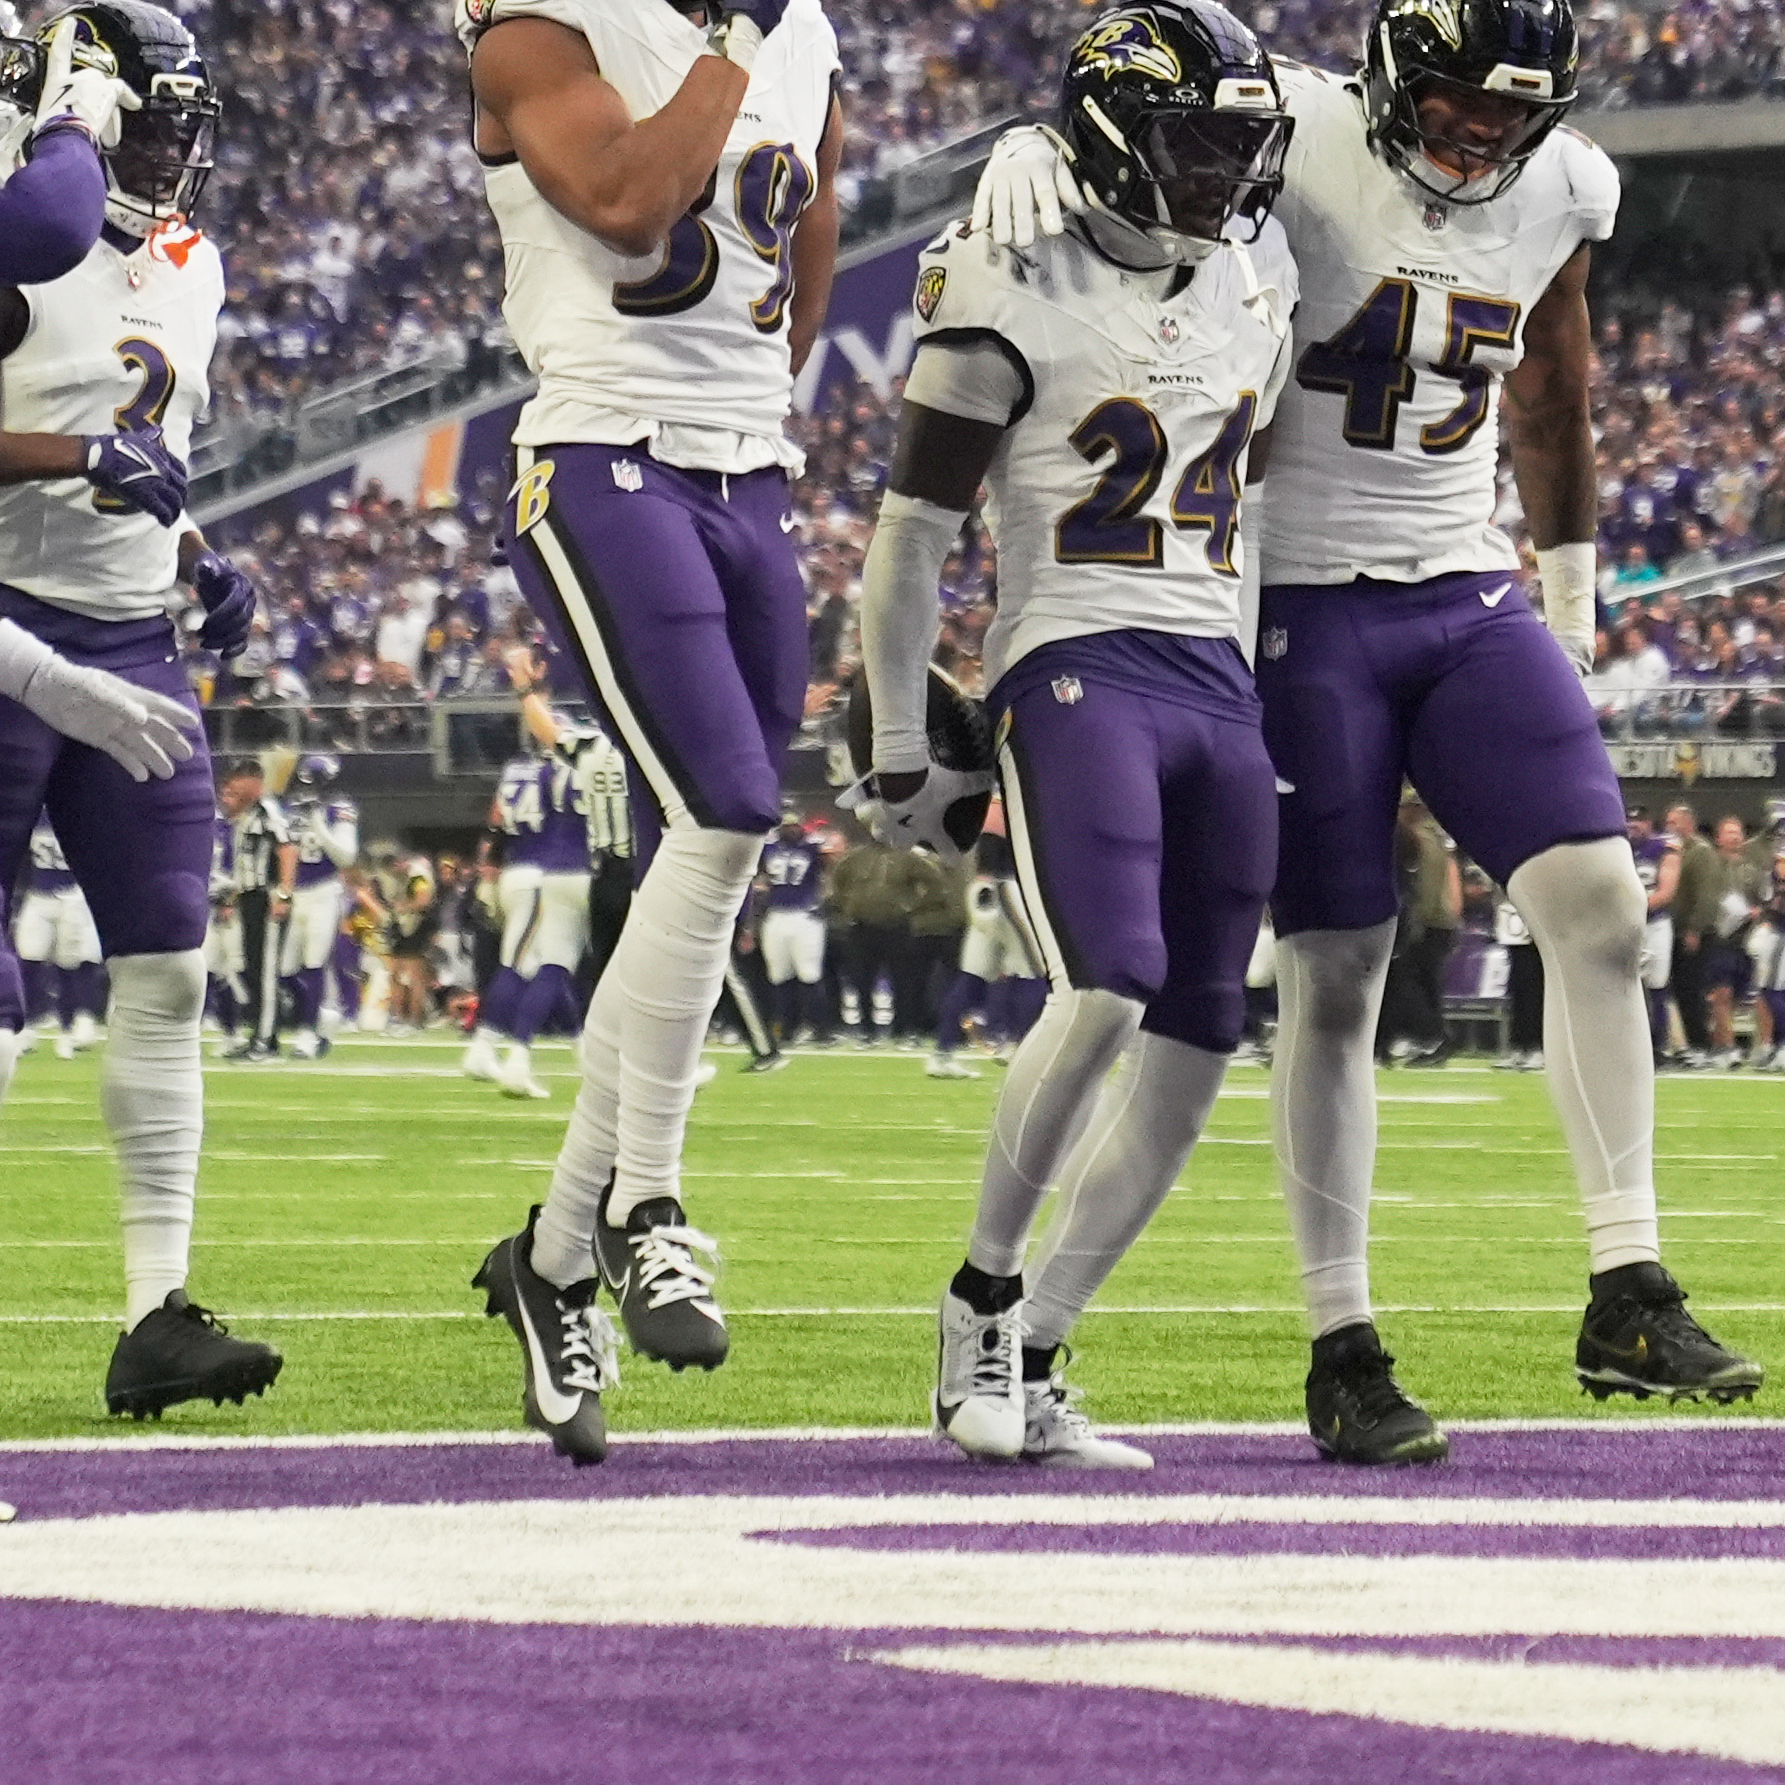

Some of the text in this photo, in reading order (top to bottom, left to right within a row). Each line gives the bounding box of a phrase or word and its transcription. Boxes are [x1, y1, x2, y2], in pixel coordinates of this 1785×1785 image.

[1397, 265, 1460, 285] RAVENS
[120, 314, 164, 331] RAVENS
[1296, 277, 1522, 455] 45
[1147, 373, 1205, 386] RAVENS
[1054, 389, 1258, 579] 24
